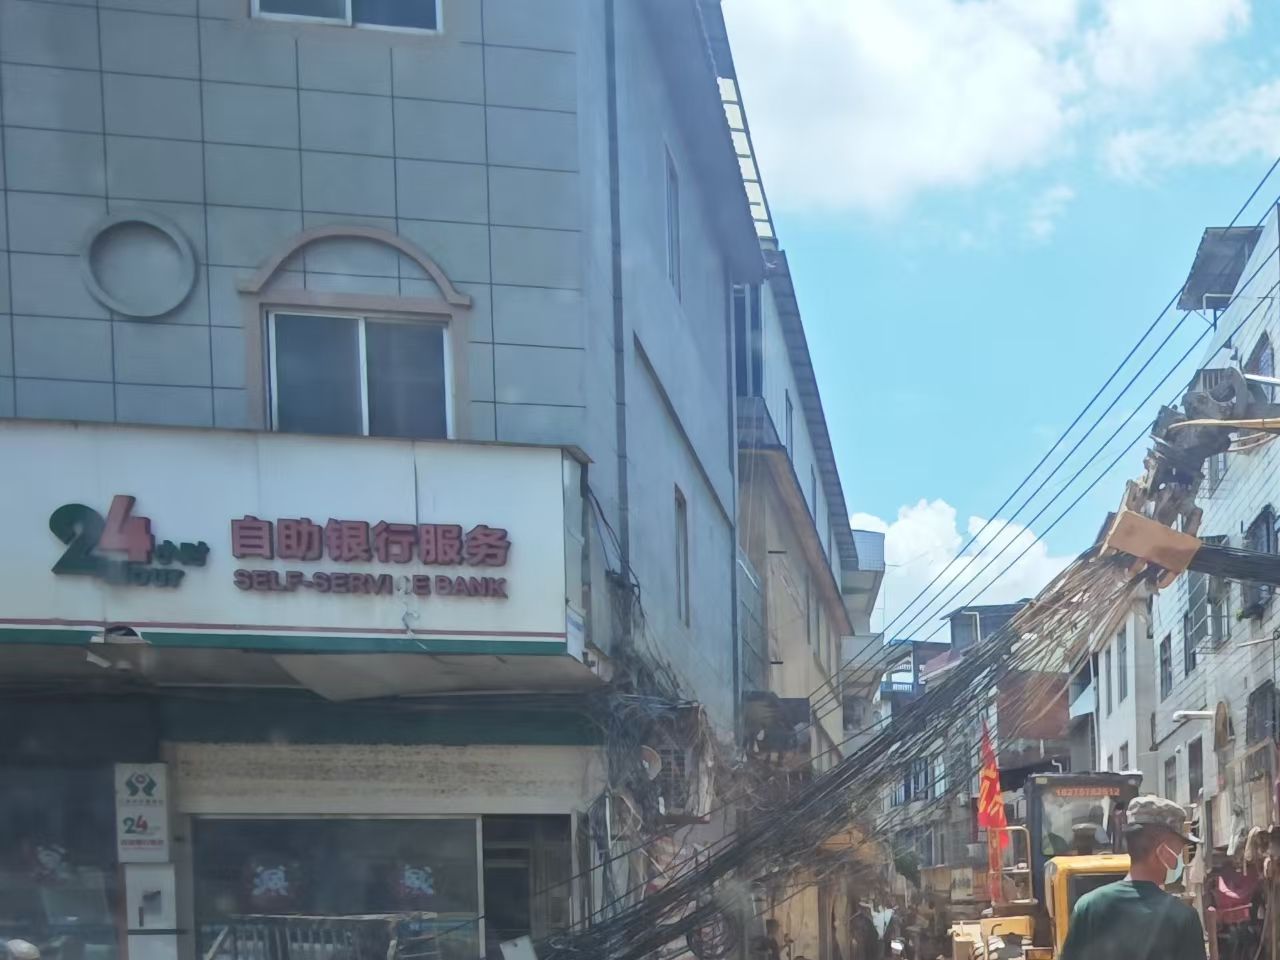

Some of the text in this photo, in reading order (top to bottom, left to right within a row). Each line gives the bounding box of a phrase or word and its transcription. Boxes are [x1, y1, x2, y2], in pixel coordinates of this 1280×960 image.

[49, 494, 156, 575] 24
[231, 515, 511, 567] 自助银行服务
[233, 568, 508, 599] SELF-SERVIE BANK
[122, 815, 148, 834] 24
